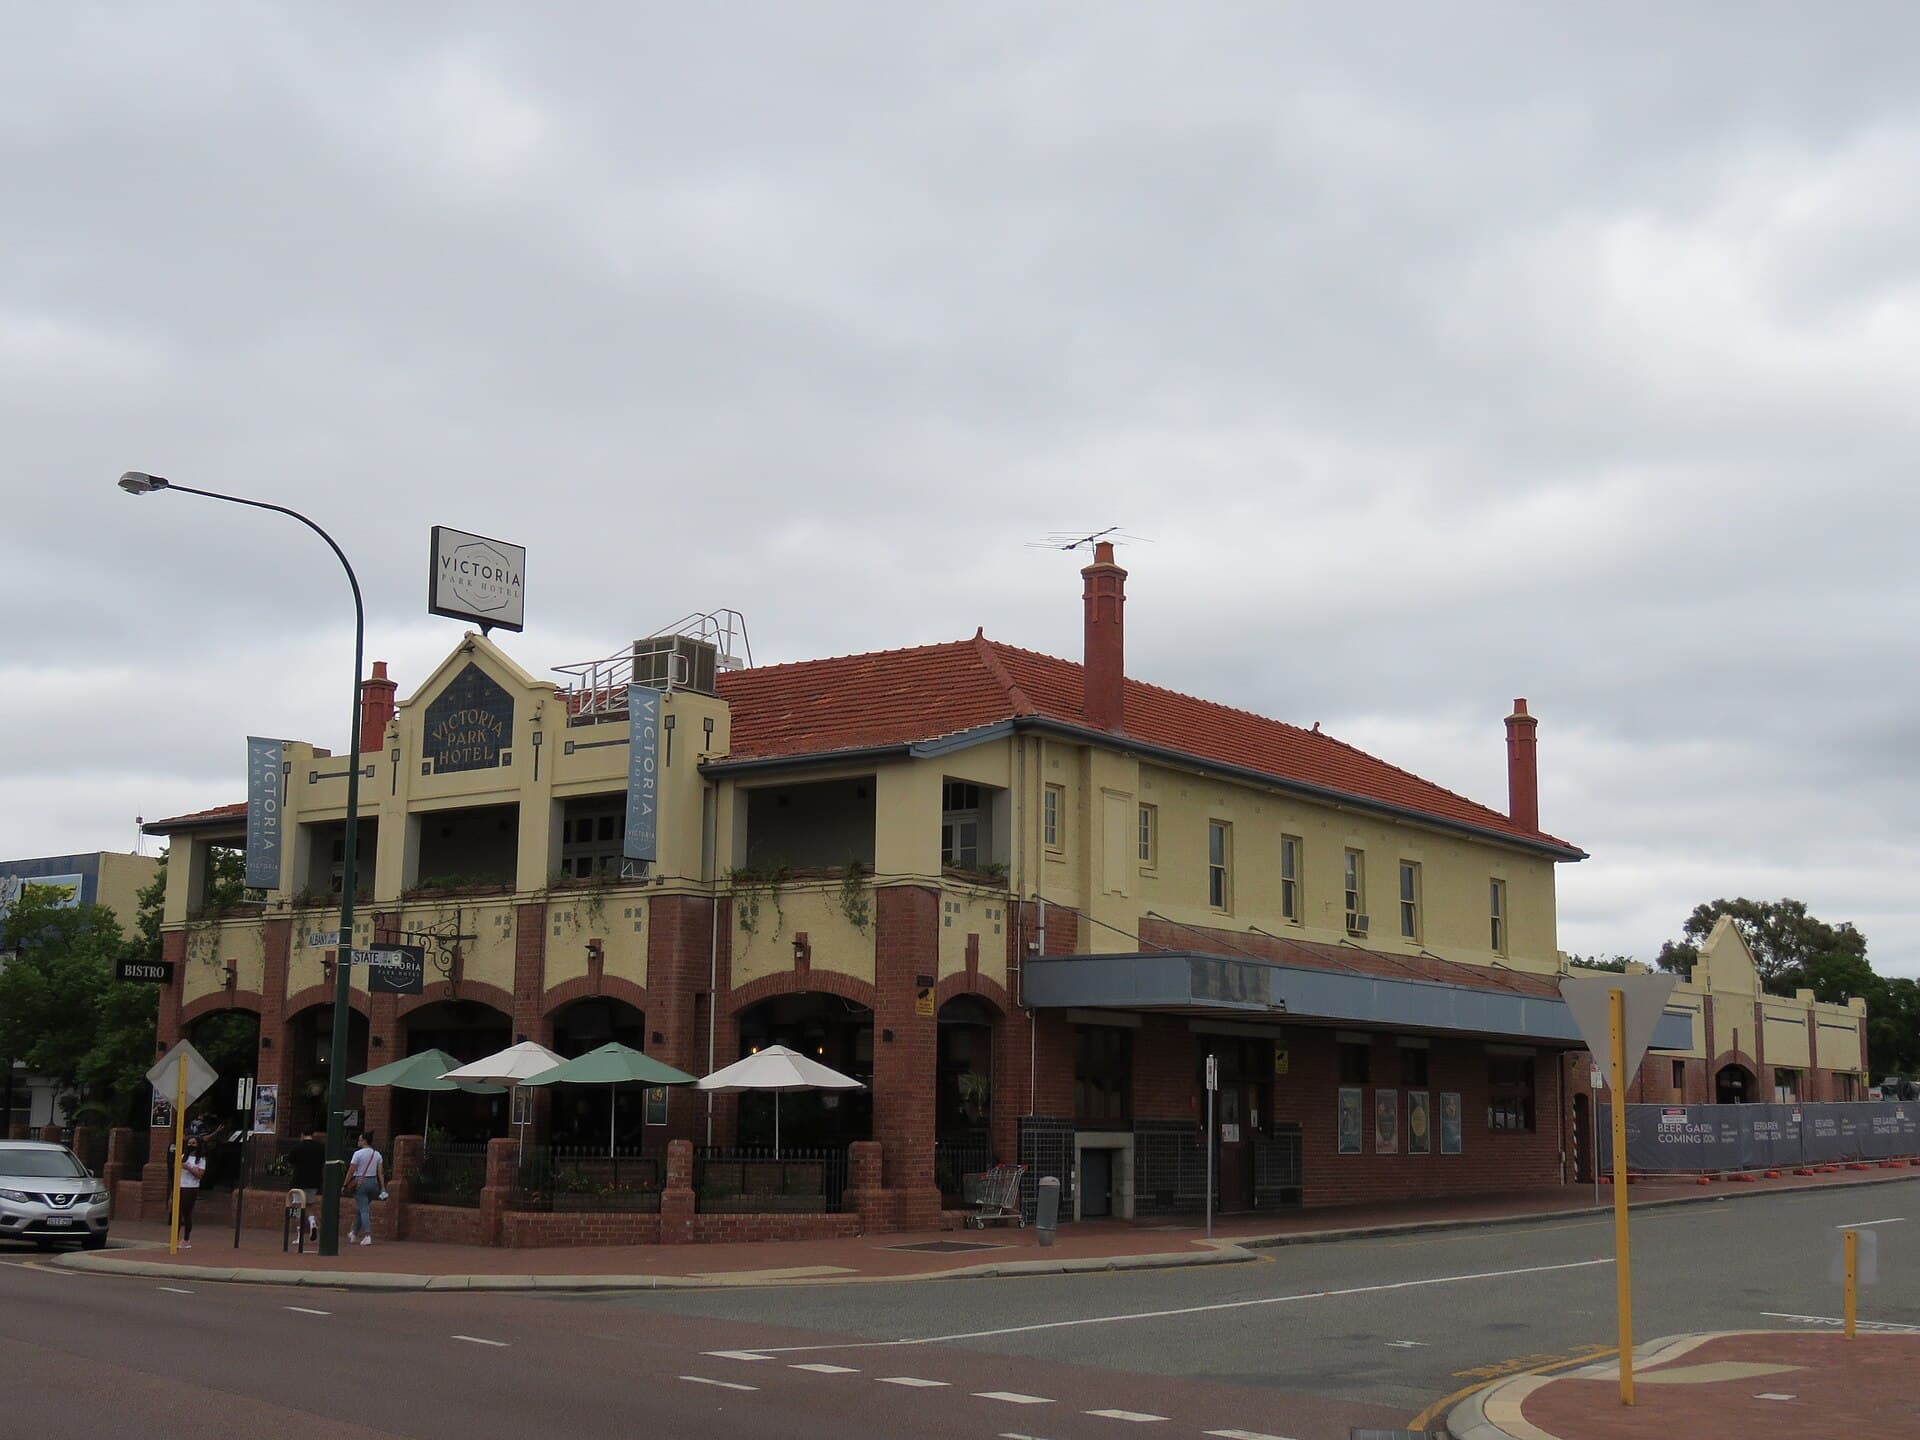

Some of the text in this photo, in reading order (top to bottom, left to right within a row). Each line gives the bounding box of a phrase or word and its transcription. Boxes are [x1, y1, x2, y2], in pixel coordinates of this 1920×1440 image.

[441, 555, 520, 587] VICTORIA
[441, 573, 519, 599] PARK HOTEL
[431, 708, 503, 740] VICTORIA
[447, 729, 486, 746] PARK
[439, 746, 494, 765] HOTEL
[643, 700, 655, 816] VICTORIA
[263, 748, 277, 850] VICTORIA
[309, 933, 328, 945] ALBANY
[354, 951, 379, 963] STATE
[124, 965, 165, 978] BISTRO
[1657, 1123, 1682, 1133] BEER
[1658, 1134, 1701, 1143] COMING
